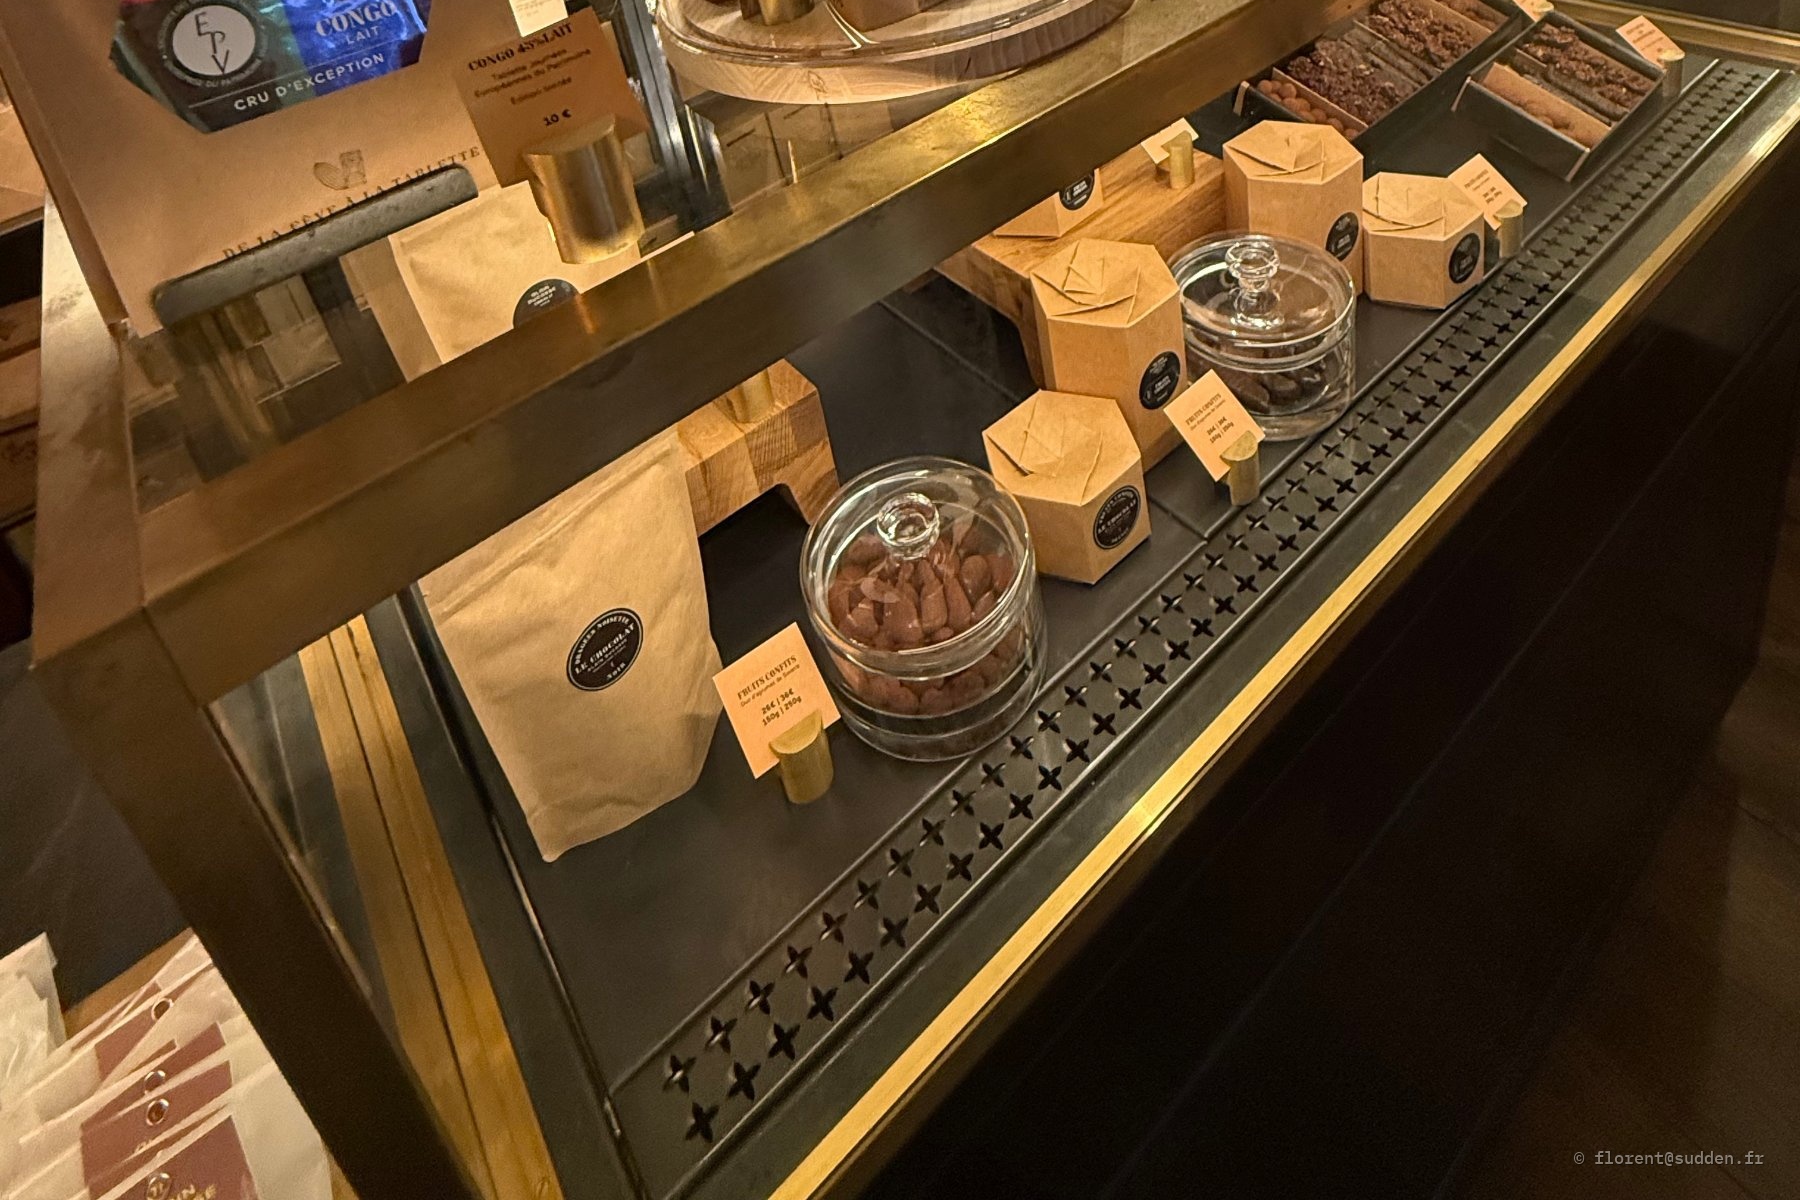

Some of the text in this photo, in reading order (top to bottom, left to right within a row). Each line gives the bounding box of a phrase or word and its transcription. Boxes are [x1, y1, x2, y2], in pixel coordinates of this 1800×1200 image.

[345, 25, 381, 46] LAIT
[468, 46, 515, 72] CONGO
[233, 52, 385, 112] CRU D'EXCEPTION
[544, 113, 560, 127] 10
[574, 661, 589, 675] LE
[590, 622, 635, 664] CHOCOLAT
[737, 675, 766, 701] FRUITS
[764, 654, 798, 681] CONFITS
[761, 700, 777, 715] 26€
[780, 687, 795, 702] 36€
[762, 710, 780, 727] 150g
[783, 695, 802, 711] 250g
